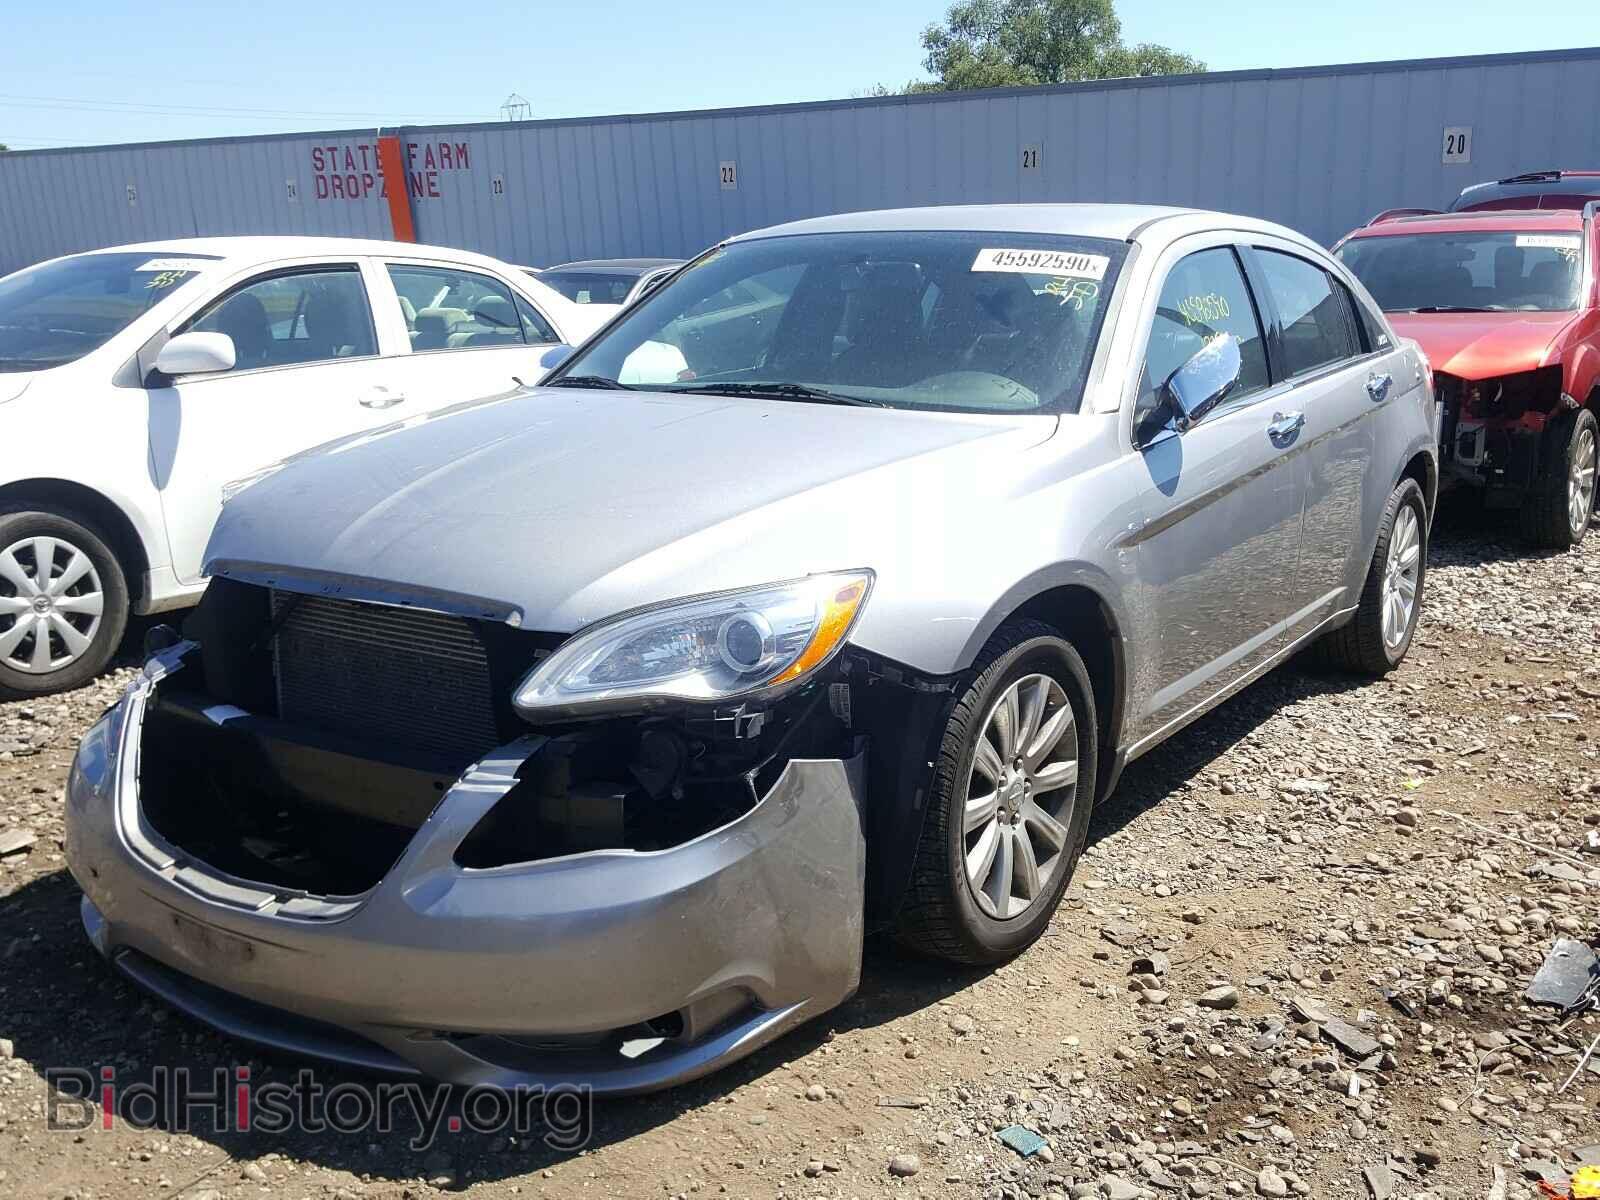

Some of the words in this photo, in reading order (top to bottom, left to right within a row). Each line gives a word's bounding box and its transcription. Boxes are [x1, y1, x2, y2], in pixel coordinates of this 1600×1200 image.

[1447, 134, 1465, 155] 20
[407, 142, 471, 170] FARM
[1023, 150, 1036, 168] 21
[314, 171, 440, 199] DROPZNE
[722, 167, 734, 183] 22
[992, 251, 1091, 272] 45592590
